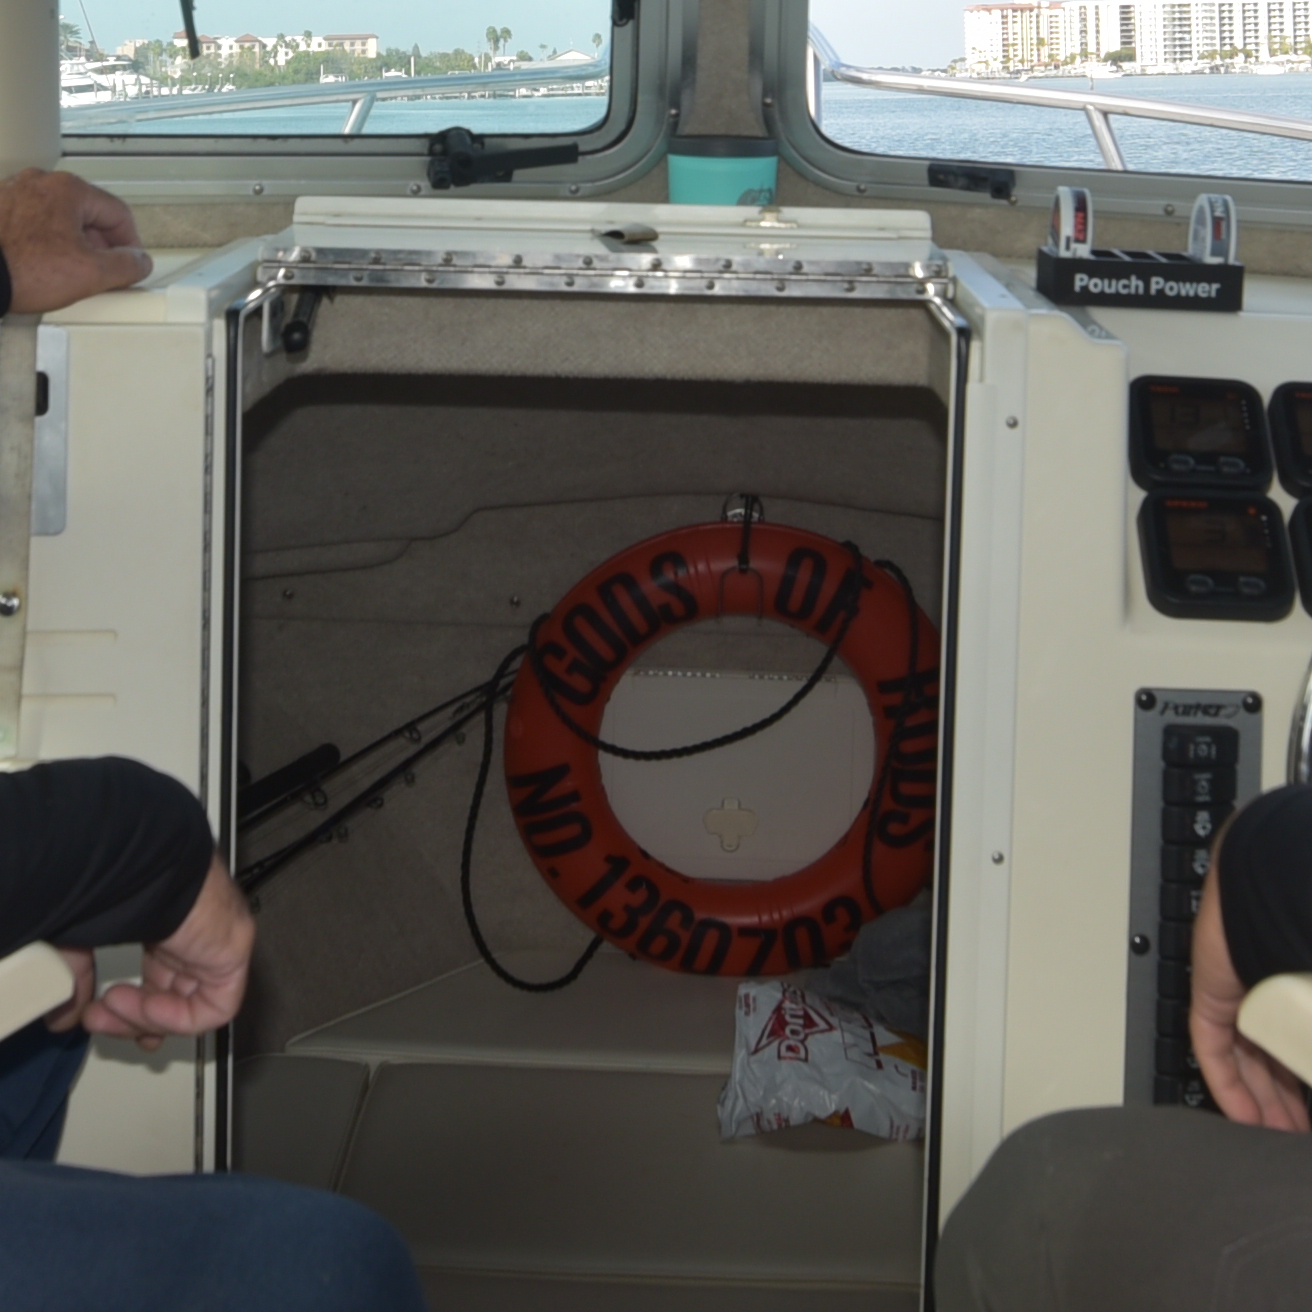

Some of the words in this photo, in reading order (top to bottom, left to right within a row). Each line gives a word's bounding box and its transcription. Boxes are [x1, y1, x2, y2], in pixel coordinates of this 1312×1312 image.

[1074, 273, 1144, 295] Pouch
[1149, 276, 1221, 298] Power
[534, 550, 698, 706] GODS
[773, 547, 873, 636] OF
